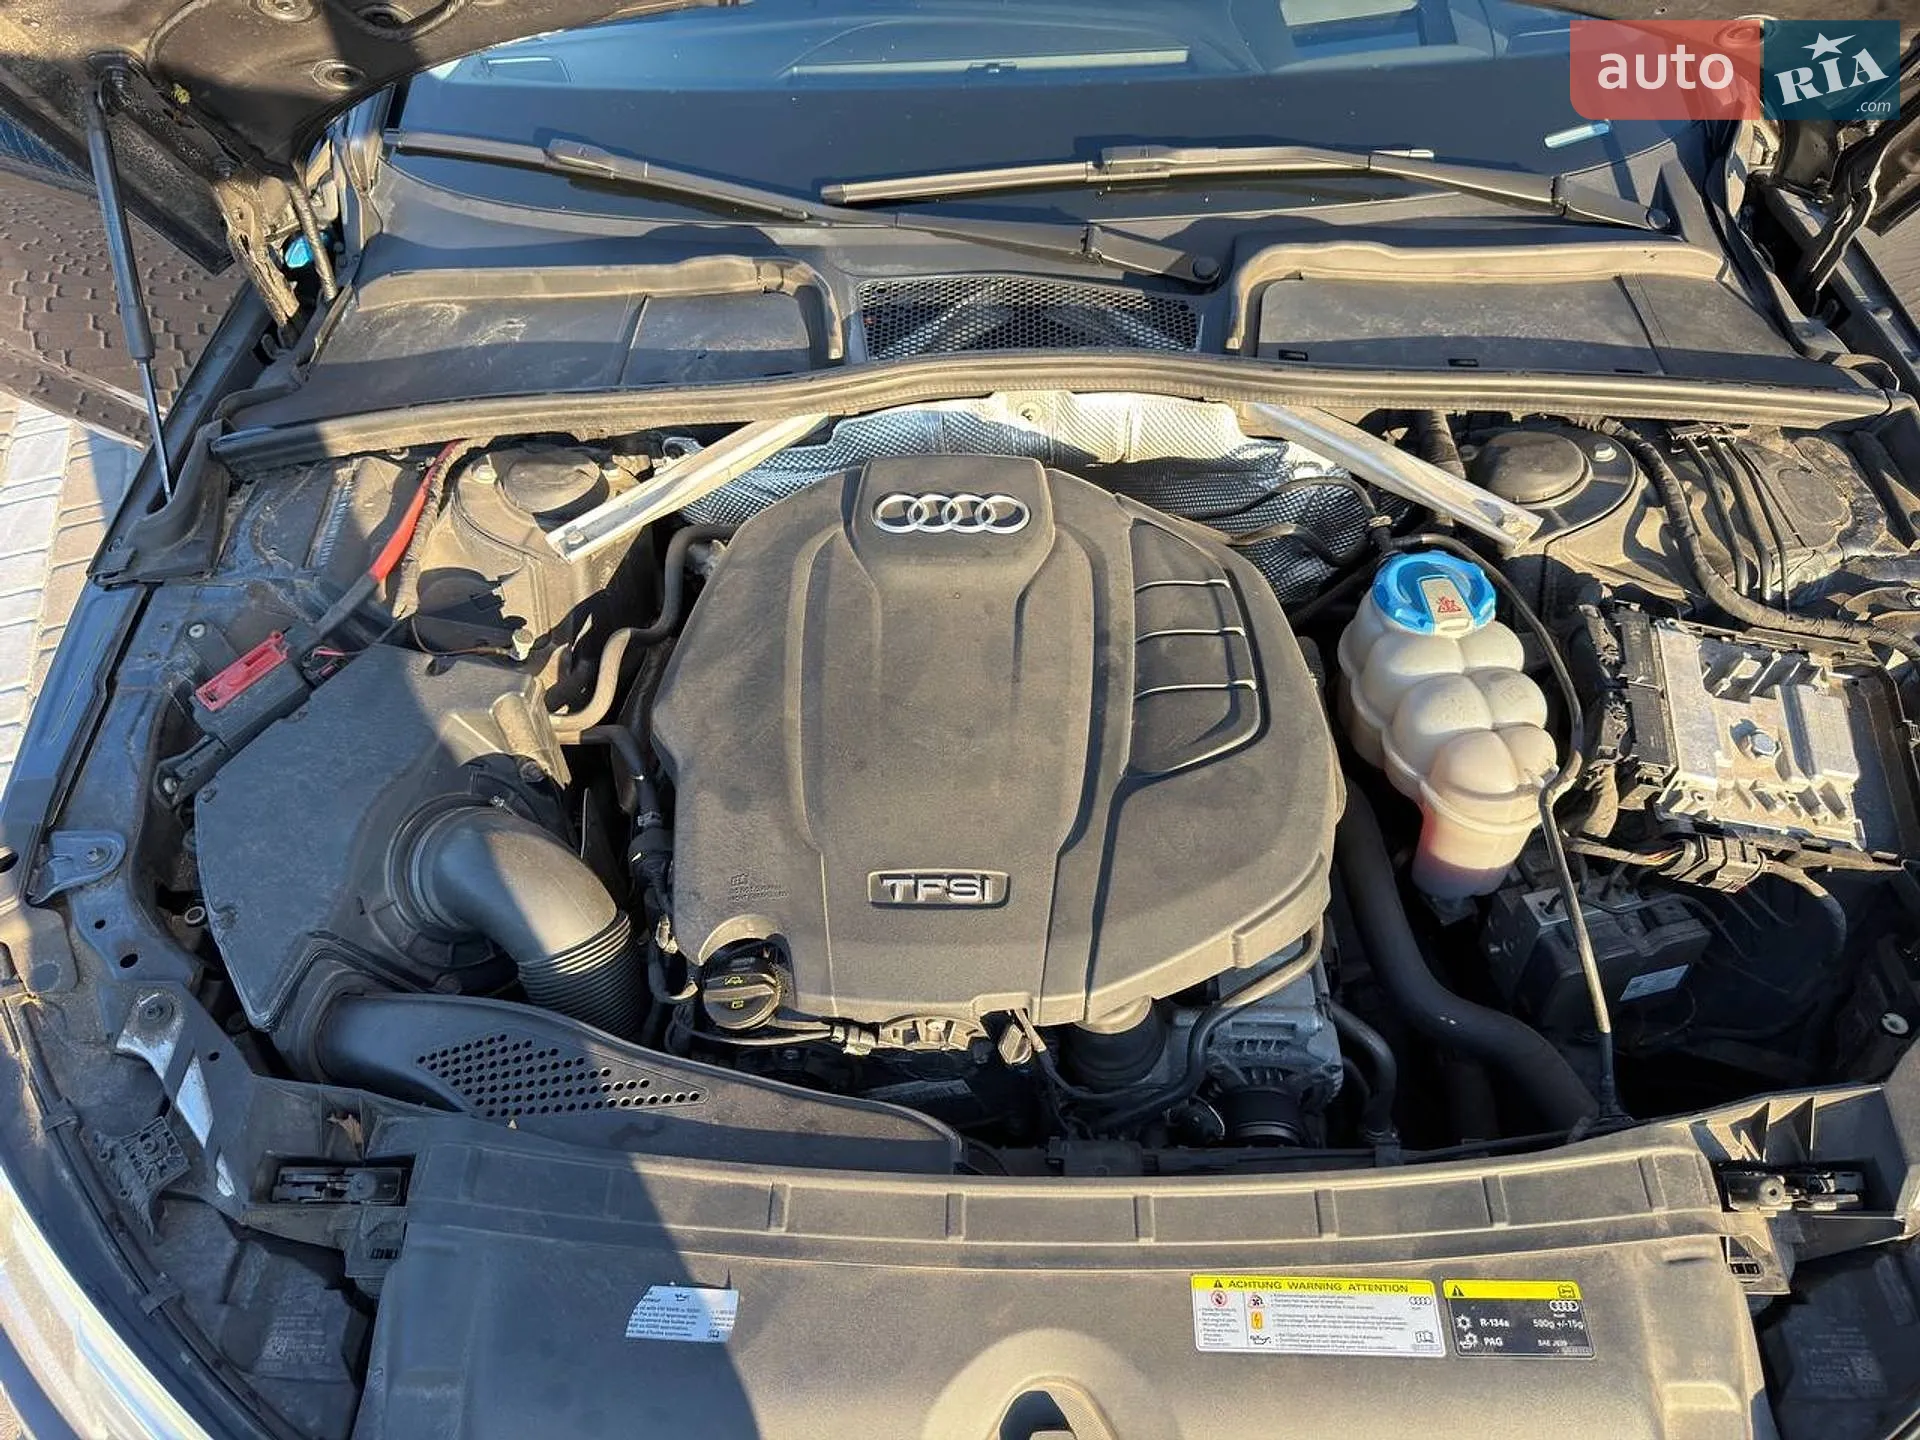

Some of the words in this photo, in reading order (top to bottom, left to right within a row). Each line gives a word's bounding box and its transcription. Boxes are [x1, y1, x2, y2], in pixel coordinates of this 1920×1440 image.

[878, 873, 994, 903] TFSI
[1228, 1280, 1282, 1290] ACHTUNG
[1287, 1281, 1342, 1291] WARNING
[1348, 1283, 1409, 1293] ATTENTION
